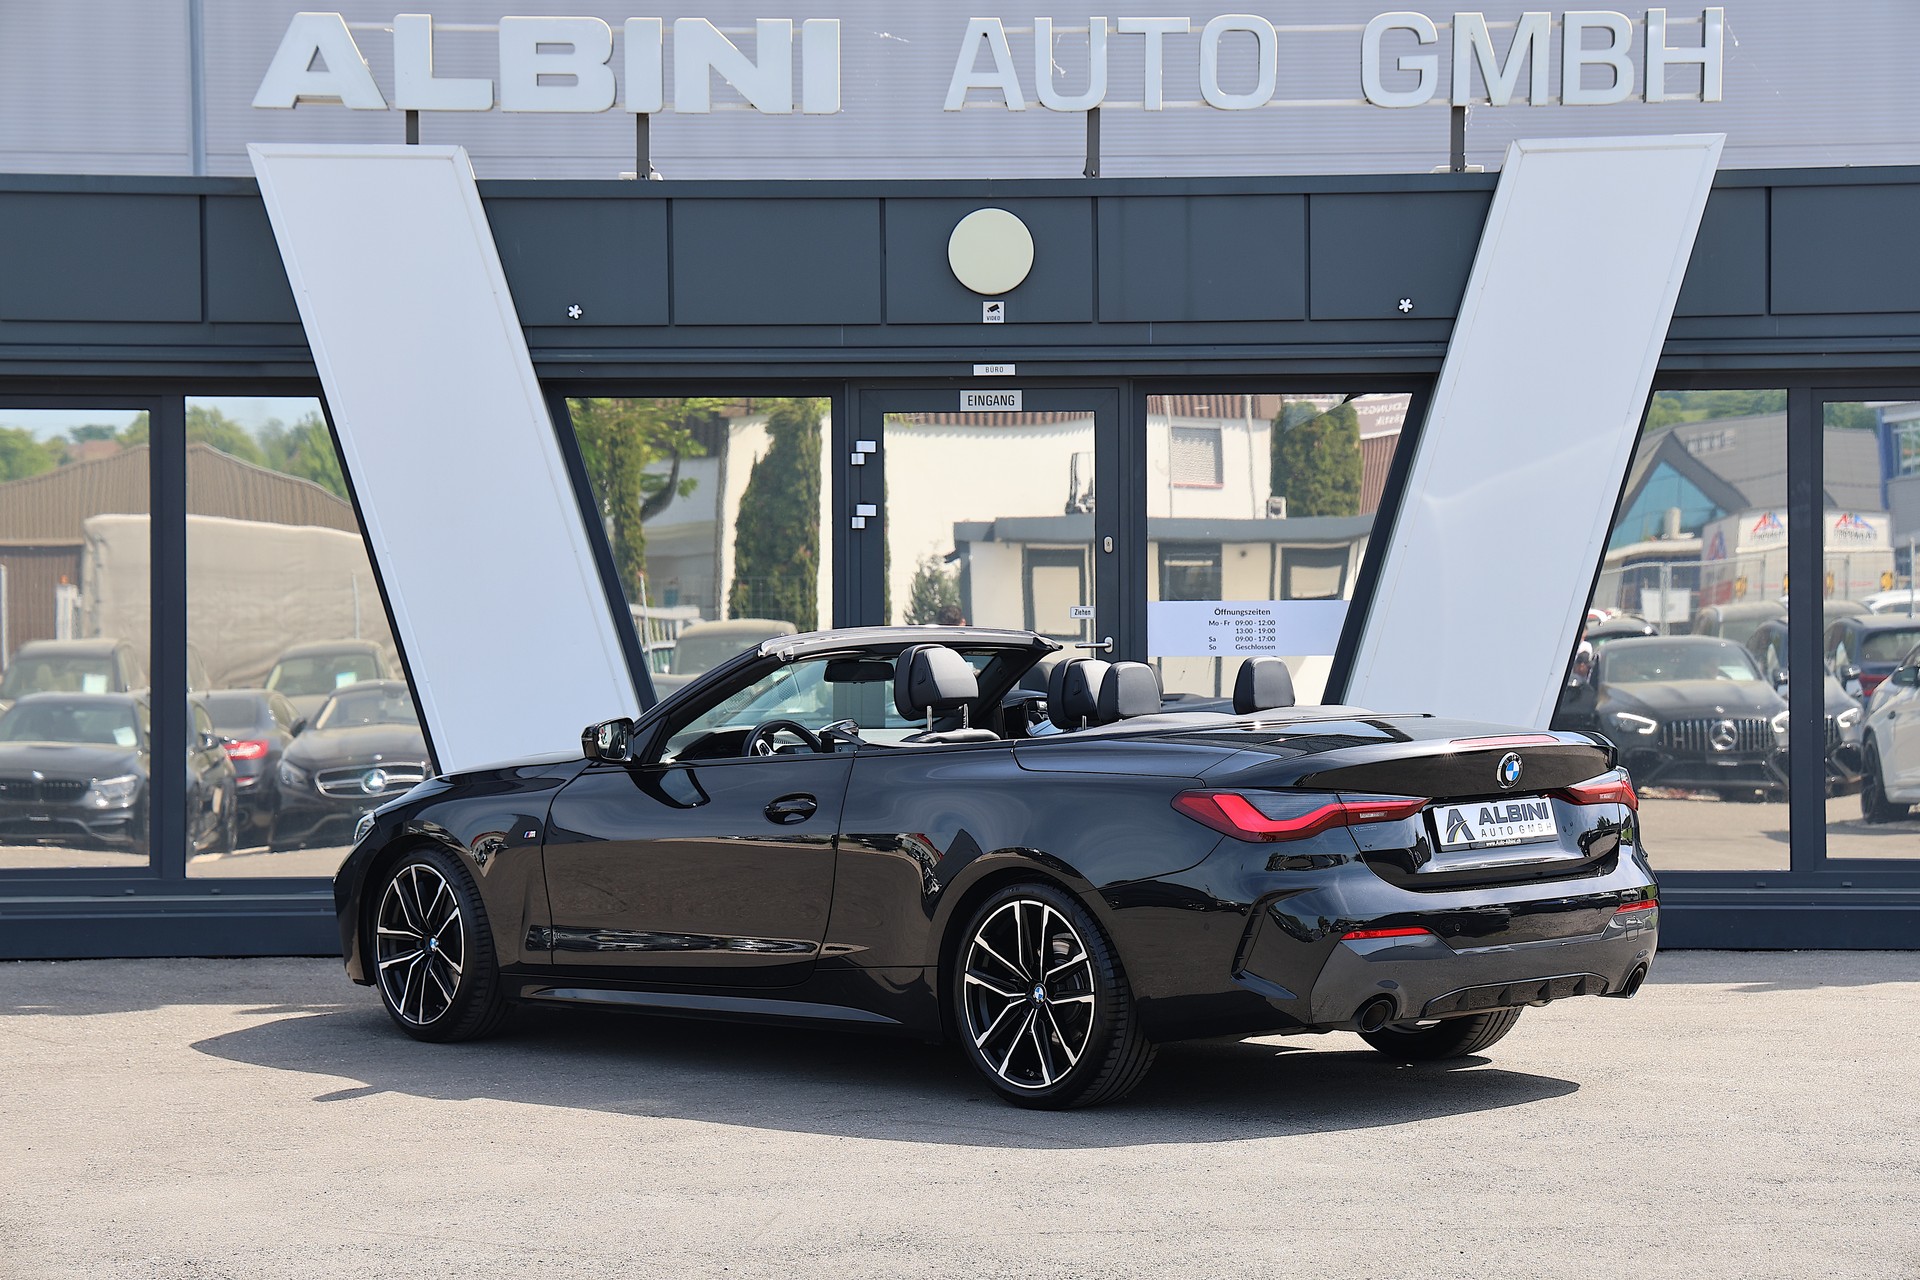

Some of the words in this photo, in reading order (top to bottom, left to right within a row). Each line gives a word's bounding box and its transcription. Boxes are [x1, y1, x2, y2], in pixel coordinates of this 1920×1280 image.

[252, 11, 841, 114] ALBINI
[943, 14, 1278, 112] AUTO
[1360, 7, 1724, 108] GMBH
[967, 395, 1015, 406] EINGANG
[1214, 607, 1271, 617] Öffnungszeiten
[1479, 802, 1549, 826] ALBINI
[1481, 826, 1514, 838] AUTO
[1519, 822, 1553, 834] GMBH
